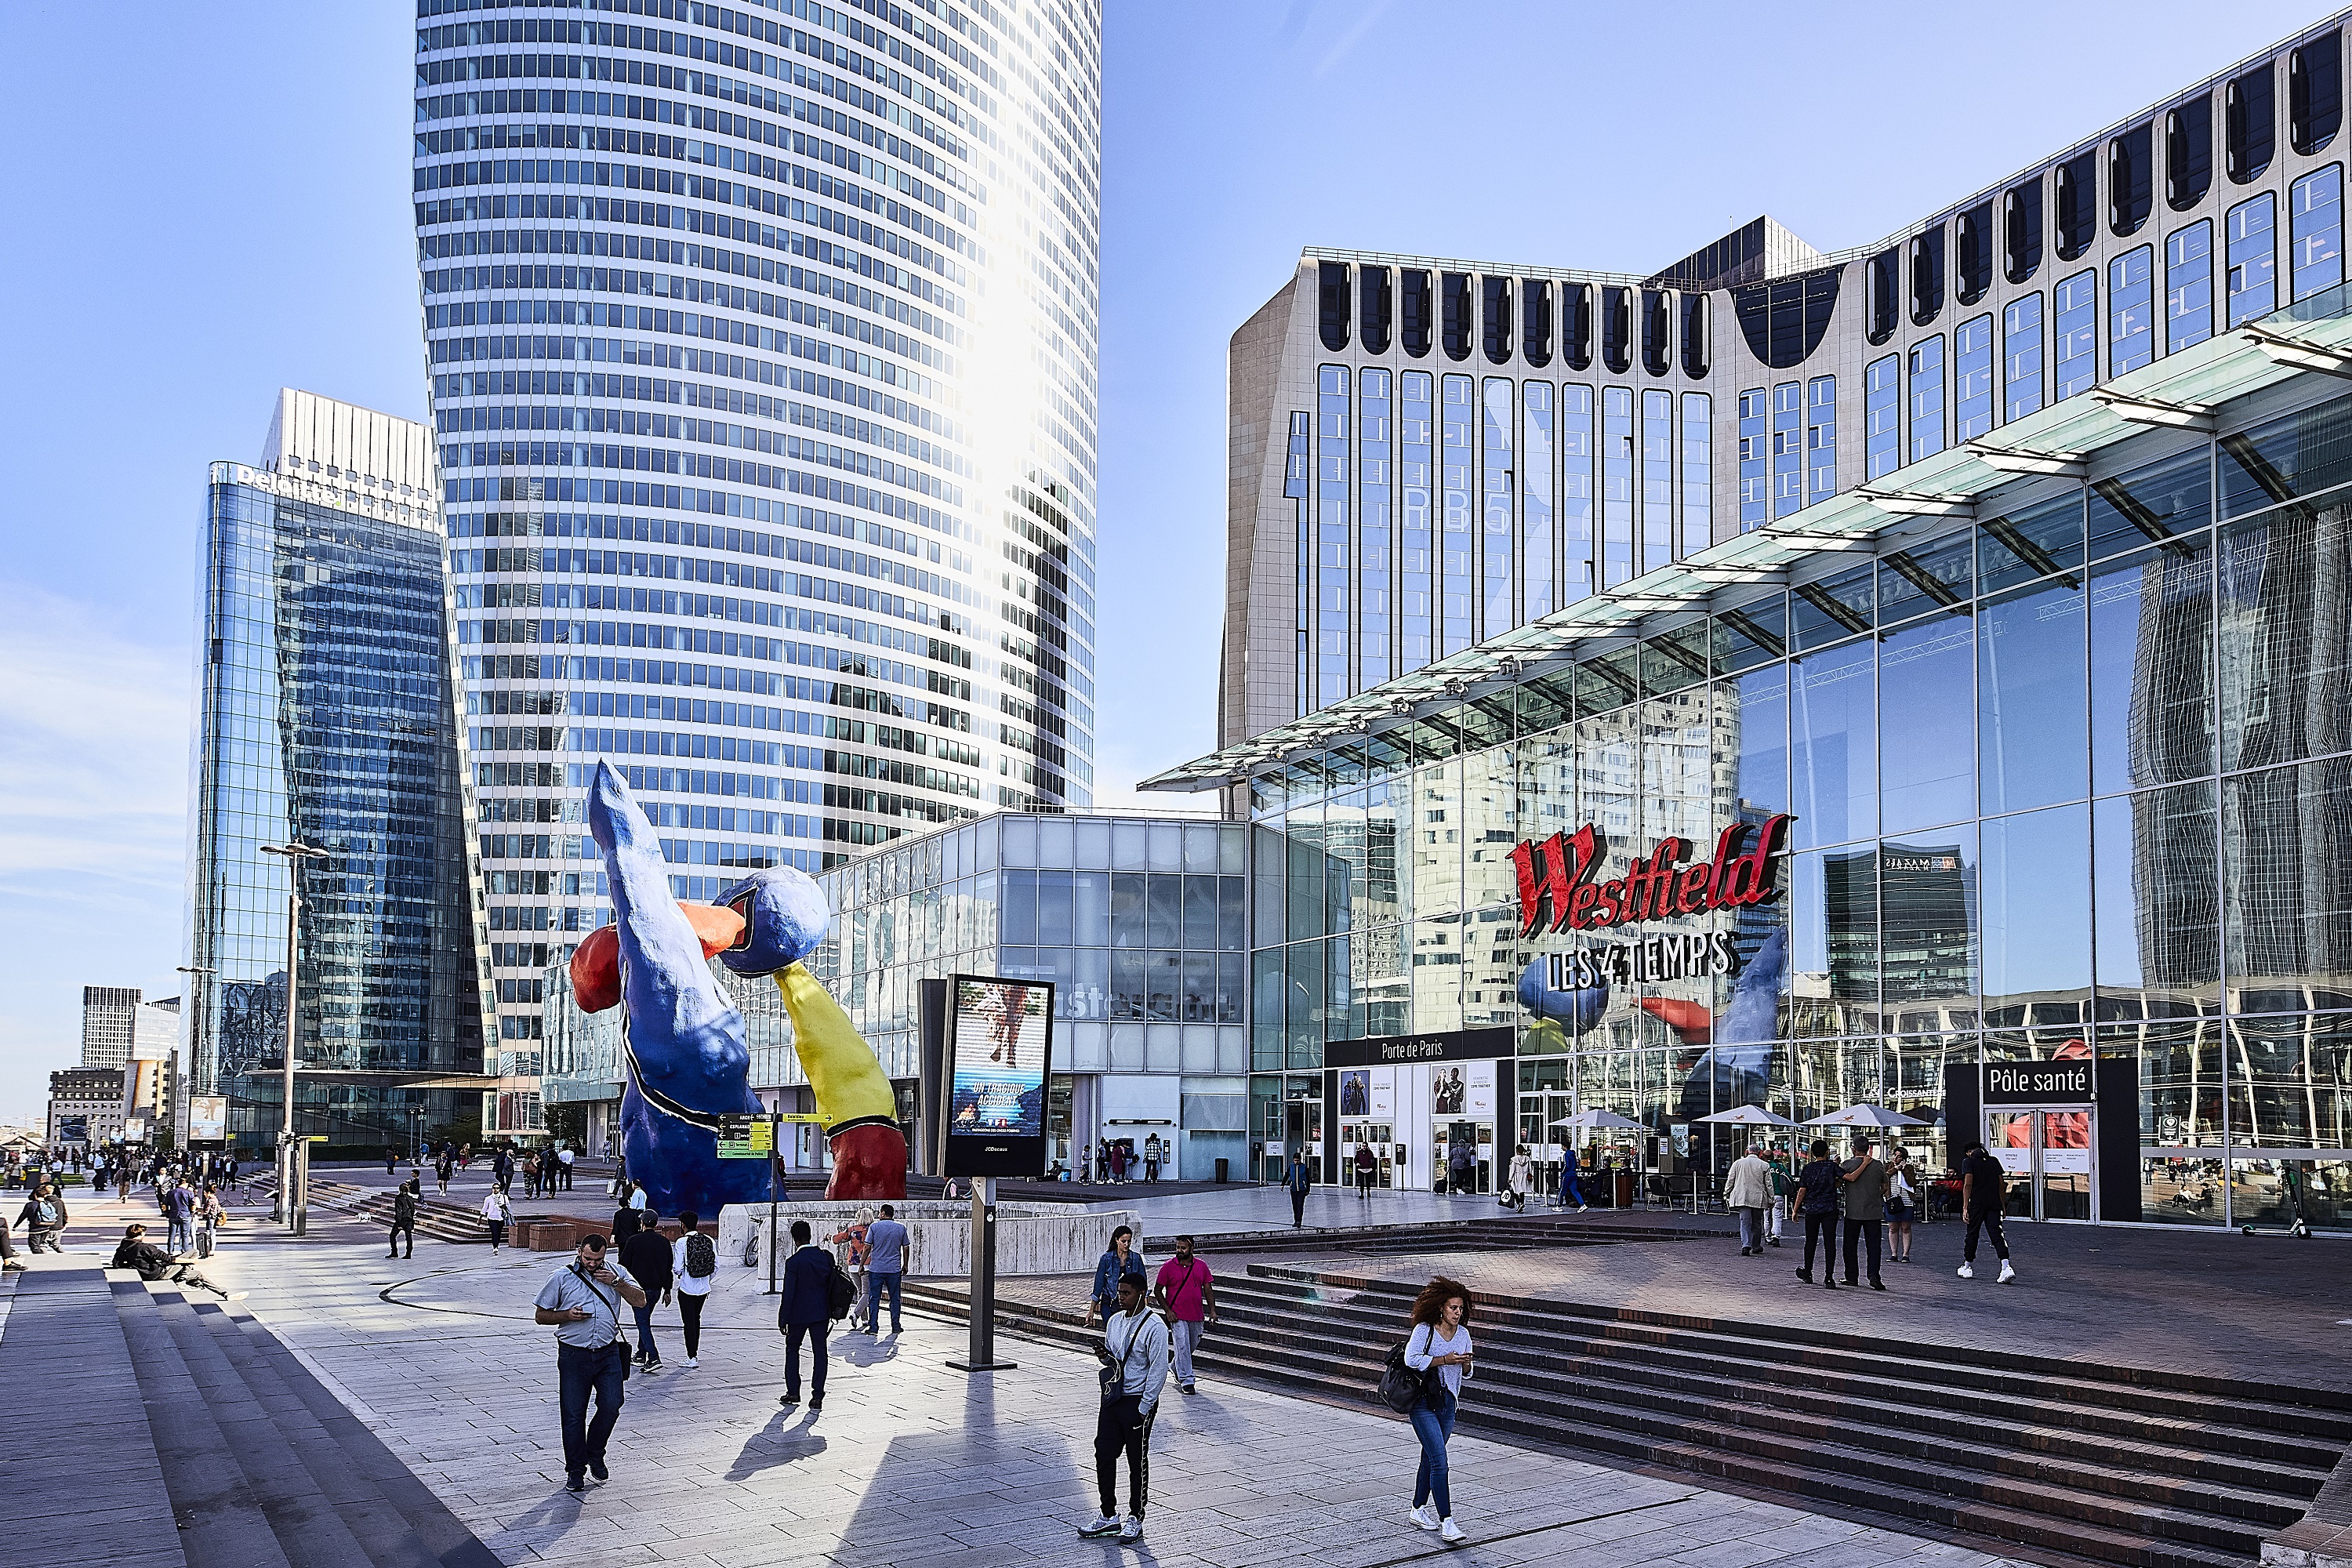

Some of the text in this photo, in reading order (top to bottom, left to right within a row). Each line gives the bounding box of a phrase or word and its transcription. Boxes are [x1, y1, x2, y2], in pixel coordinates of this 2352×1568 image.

[1505, 814, 1791, 938] Westfield
[1546, 929, 1730, 992] LES 4 TEMPS
[1382, 1039, 1443, 1059] Porte de Paris
[974, 1082, 1025, 1094] UN TRAGIQUE
[1990, 1066, 2085, 1092] Pôle santé
[977, 1094, 1018, 1106] ACCIDENT
